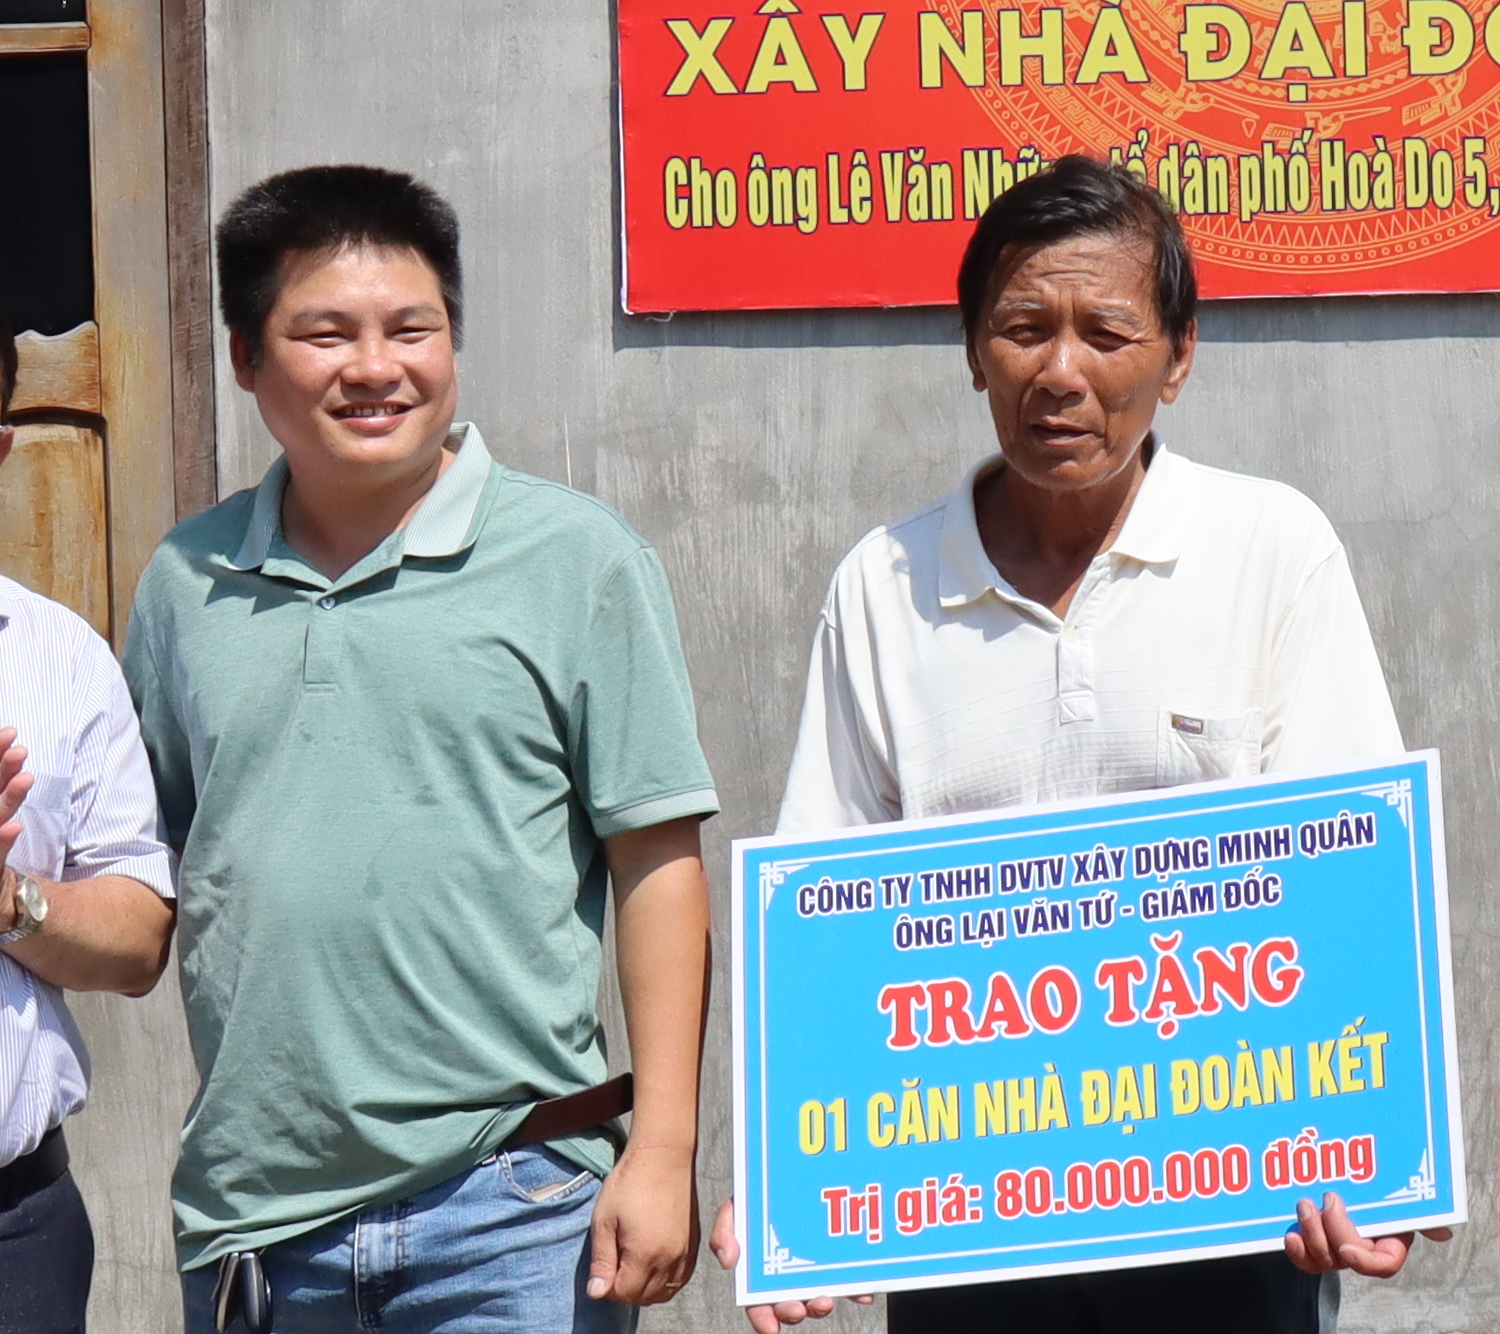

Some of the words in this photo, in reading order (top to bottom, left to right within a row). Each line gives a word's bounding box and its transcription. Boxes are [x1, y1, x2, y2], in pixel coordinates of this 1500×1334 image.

[1180, 1, 1367, 101] ĐẠI
[665, 158, 736, 228] Cho
[747, 155, 817, 233] ông
[827, 151, 871, 224] Lê
[882, 148, 952, 221] Văn
[963, 148, 1054, 219] Nh
[1159, 142, 1230, 214] dân
[1241, 129, 1310, 220] phố
[1320, 138, 1394, 212] Hoà
[1405, 137, 1453, 208] Do
[1464, 137, 1500, 215] 5,
[799, 877, 871, 915] CÔNG
[882, 875, 910, 906] TY
[921, 867, 991, 902] TNHH
[1001, 857, 1063, 896] DVTV
[1074, 846, 1125, 885] XÂY
[1135, 837, 1208, 878] DỰNG
[1219, 827, 1290, 865] MINH
[1300, 812, 1374, 857] QUÂN
[896, 910, 952, 949] ÔNG
[962, 909, 1004, 946] LẠI
[1015, 898, 1069, 935] VĂN
[1075, 892, 1115, 927] TỨ
[1142, 881, 1213, 921] GIÁM
[1223, 869, 1280, 907] ĐỐC
[879, 966, 1080, 1049] TRAO
[1096, 931, 1303, 1038] TẶNG
[800, 1100, 847, 1154] 01
[868, 1078, 958, 1146] CĂN
[976, 1064, 1068, 1134] NHÀ
[1081, 1059, 1157, 1135] ĐẠI
[1171, 1041, 1293, 1115] ĐOÀN
[1310, 1016, 1388, 1096] KẾT
[823, 1184, 881, 1242] Trị
[898, 1178, 982, 1234] giá:
[996, 1146, 1248, 1218] 80.000.000
[1264, 1128, 1375, 1192] đồng
